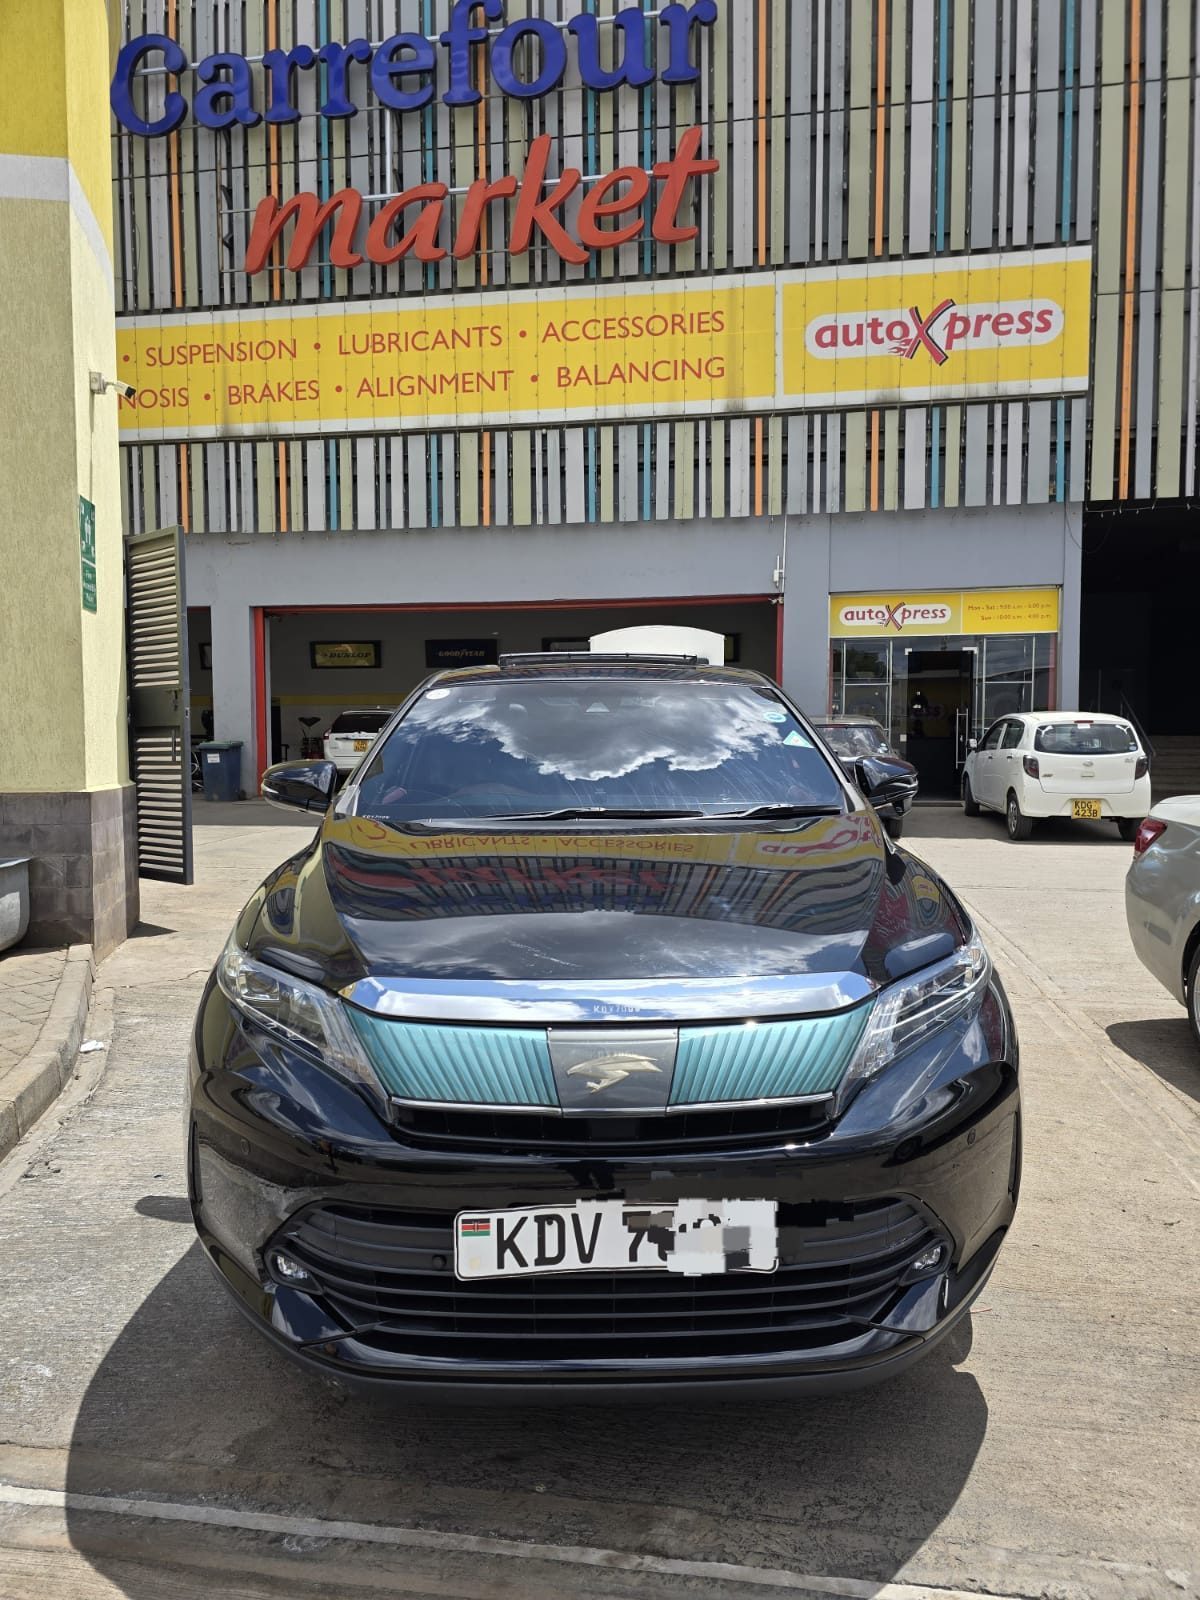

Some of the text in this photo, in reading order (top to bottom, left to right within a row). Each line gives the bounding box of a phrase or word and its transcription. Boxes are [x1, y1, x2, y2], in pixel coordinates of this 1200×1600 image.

[110, 0, 717, 137] Carrefour
[244, 126, 719, 275] market
[145, 310, 725, 367] SUSPENSION LUBRICANTS ACCESSORIES
[814, 298, 1053, 366] autoXpress
[228, 380, 320, 405] BRAKES
[356, 369, 514, 399] ALIGNMENT
[557, 356, 725, 388] BALANCING
[844, 601, 947, 631] autoXpress
[1074, 800, 1093, 809] KDG
[1074, 809, 1098, 818] 423B
[496, 1212, 603, 1271] KDV
